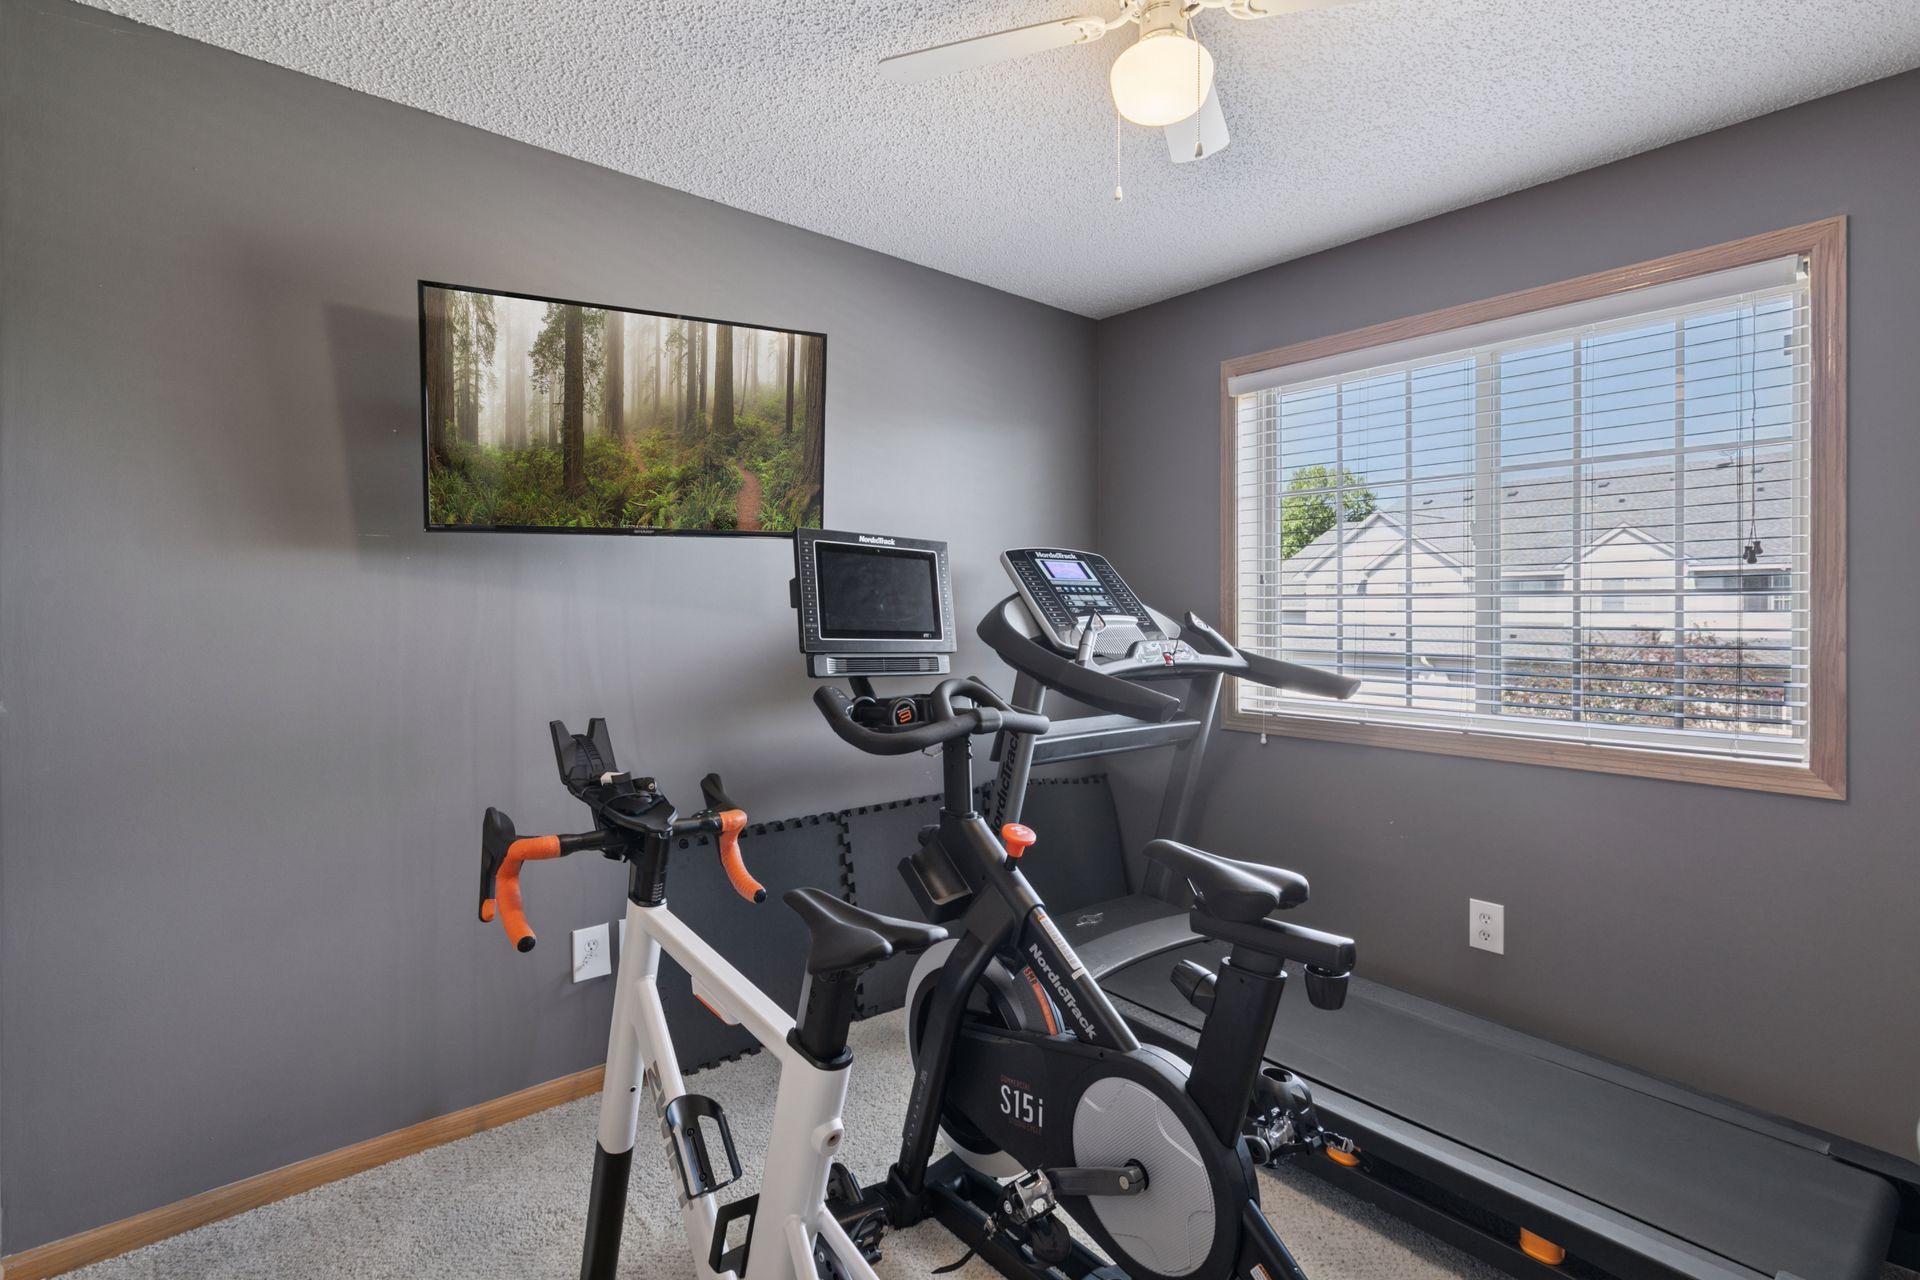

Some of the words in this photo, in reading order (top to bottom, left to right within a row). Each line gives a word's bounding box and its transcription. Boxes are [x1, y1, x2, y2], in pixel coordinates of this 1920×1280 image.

[859, 535, 896, 546] NordicTrack
[1028, 943, 1097, 1041] NordicTrack
[1000, 1084, 1043, 1128] S15i
